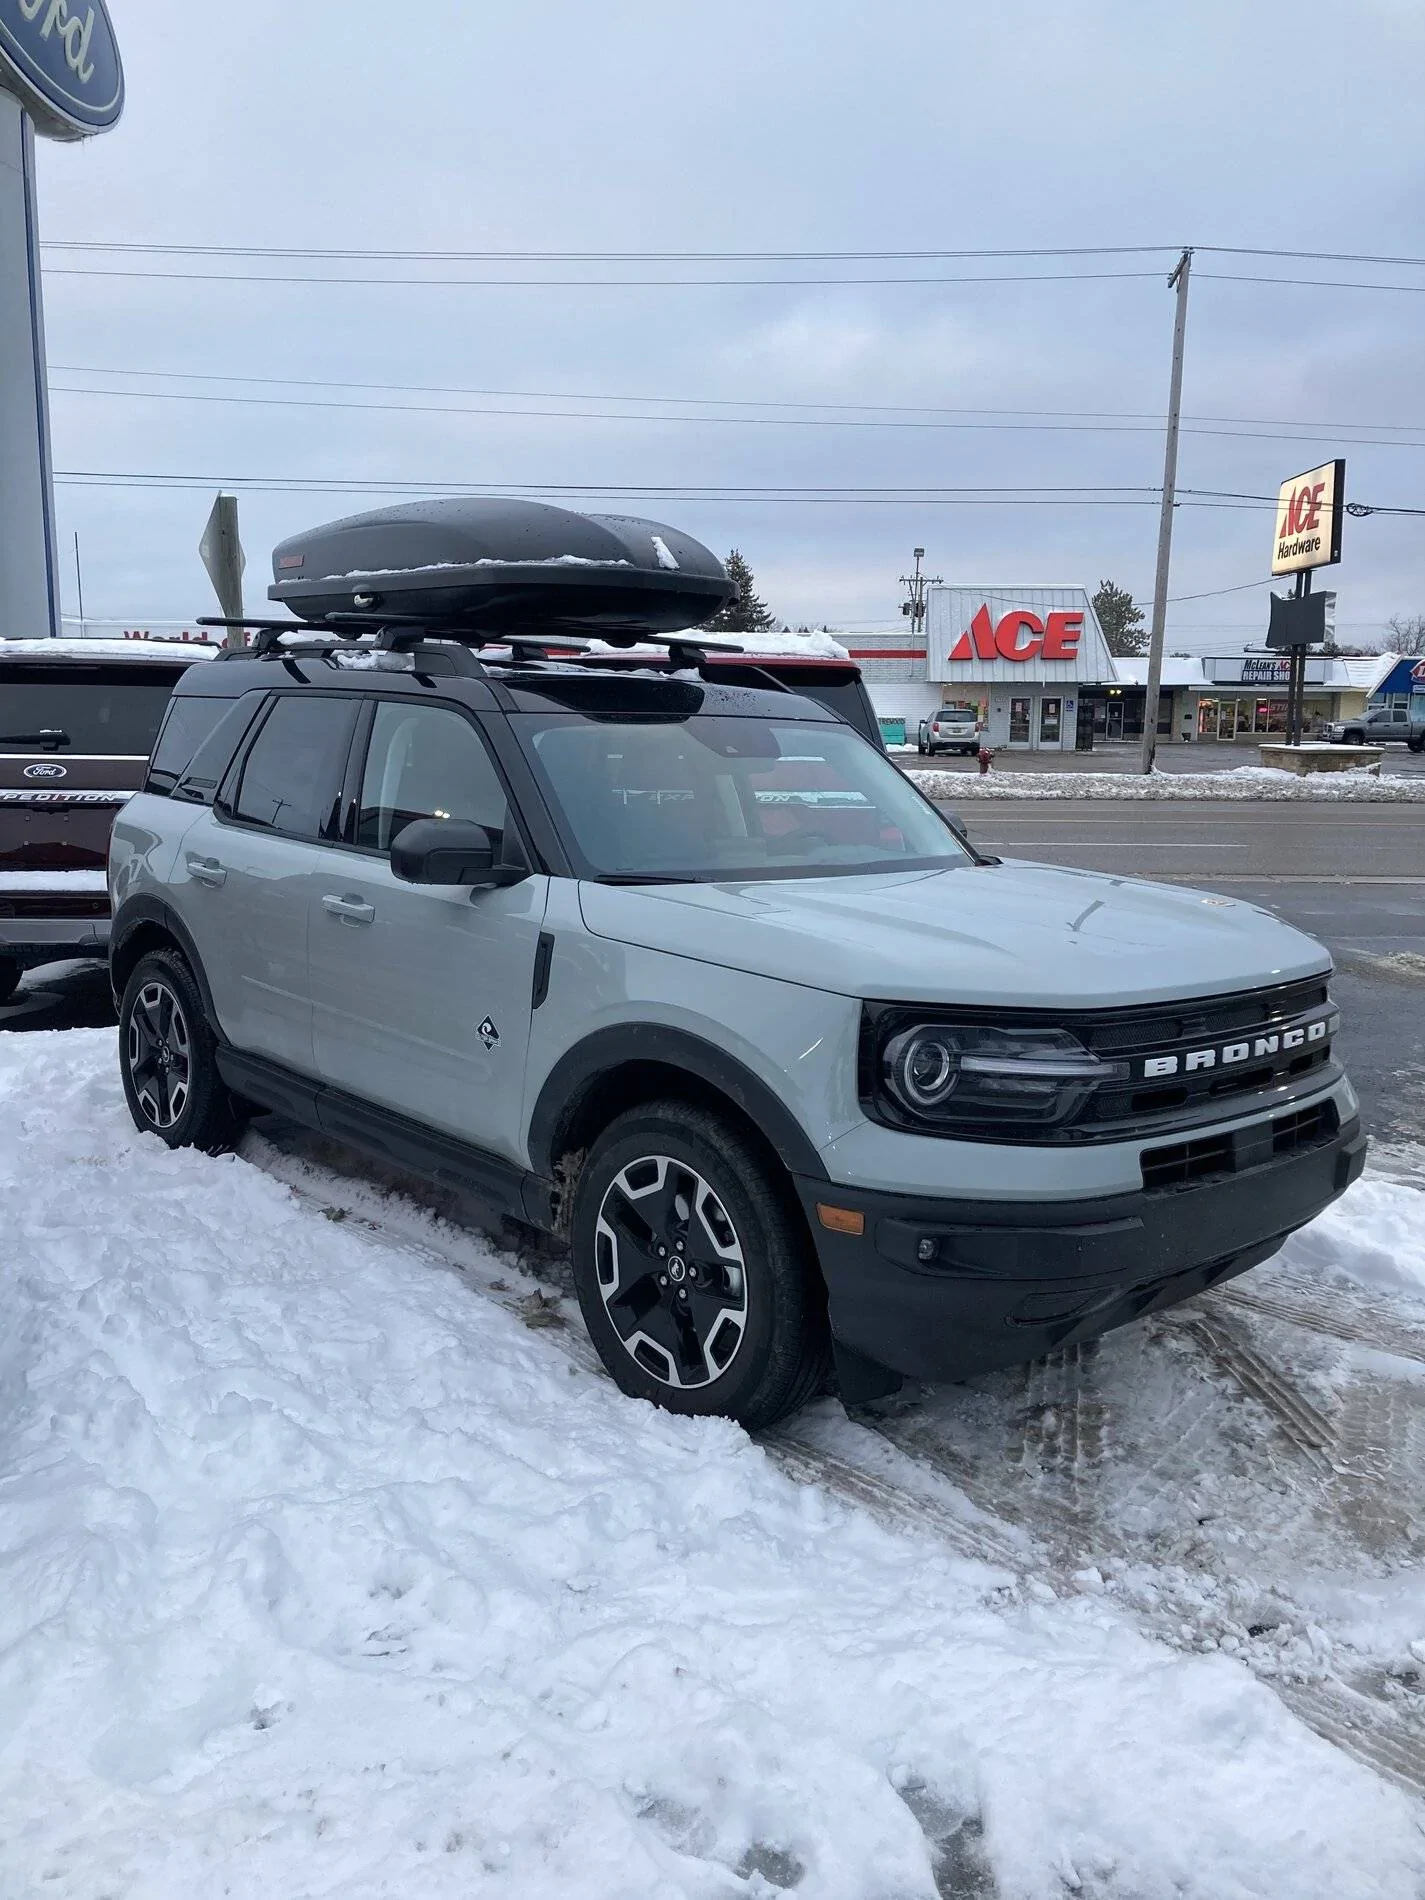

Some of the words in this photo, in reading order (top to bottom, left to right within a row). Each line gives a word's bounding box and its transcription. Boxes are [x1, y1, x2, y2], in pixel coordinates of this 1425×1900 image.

[1279, 483, 1325, 538] ACE
[1277, 536, 1321, 560] Hardware
[948, 602, 1084, 661] ACE
[1243, 670, 1272, 680] REPAIR
[1273, 670, 1290, 680] SHO
[32, 766, 57, 776] Ford
[1144, 1022, 1326, 1077] BRONCO
